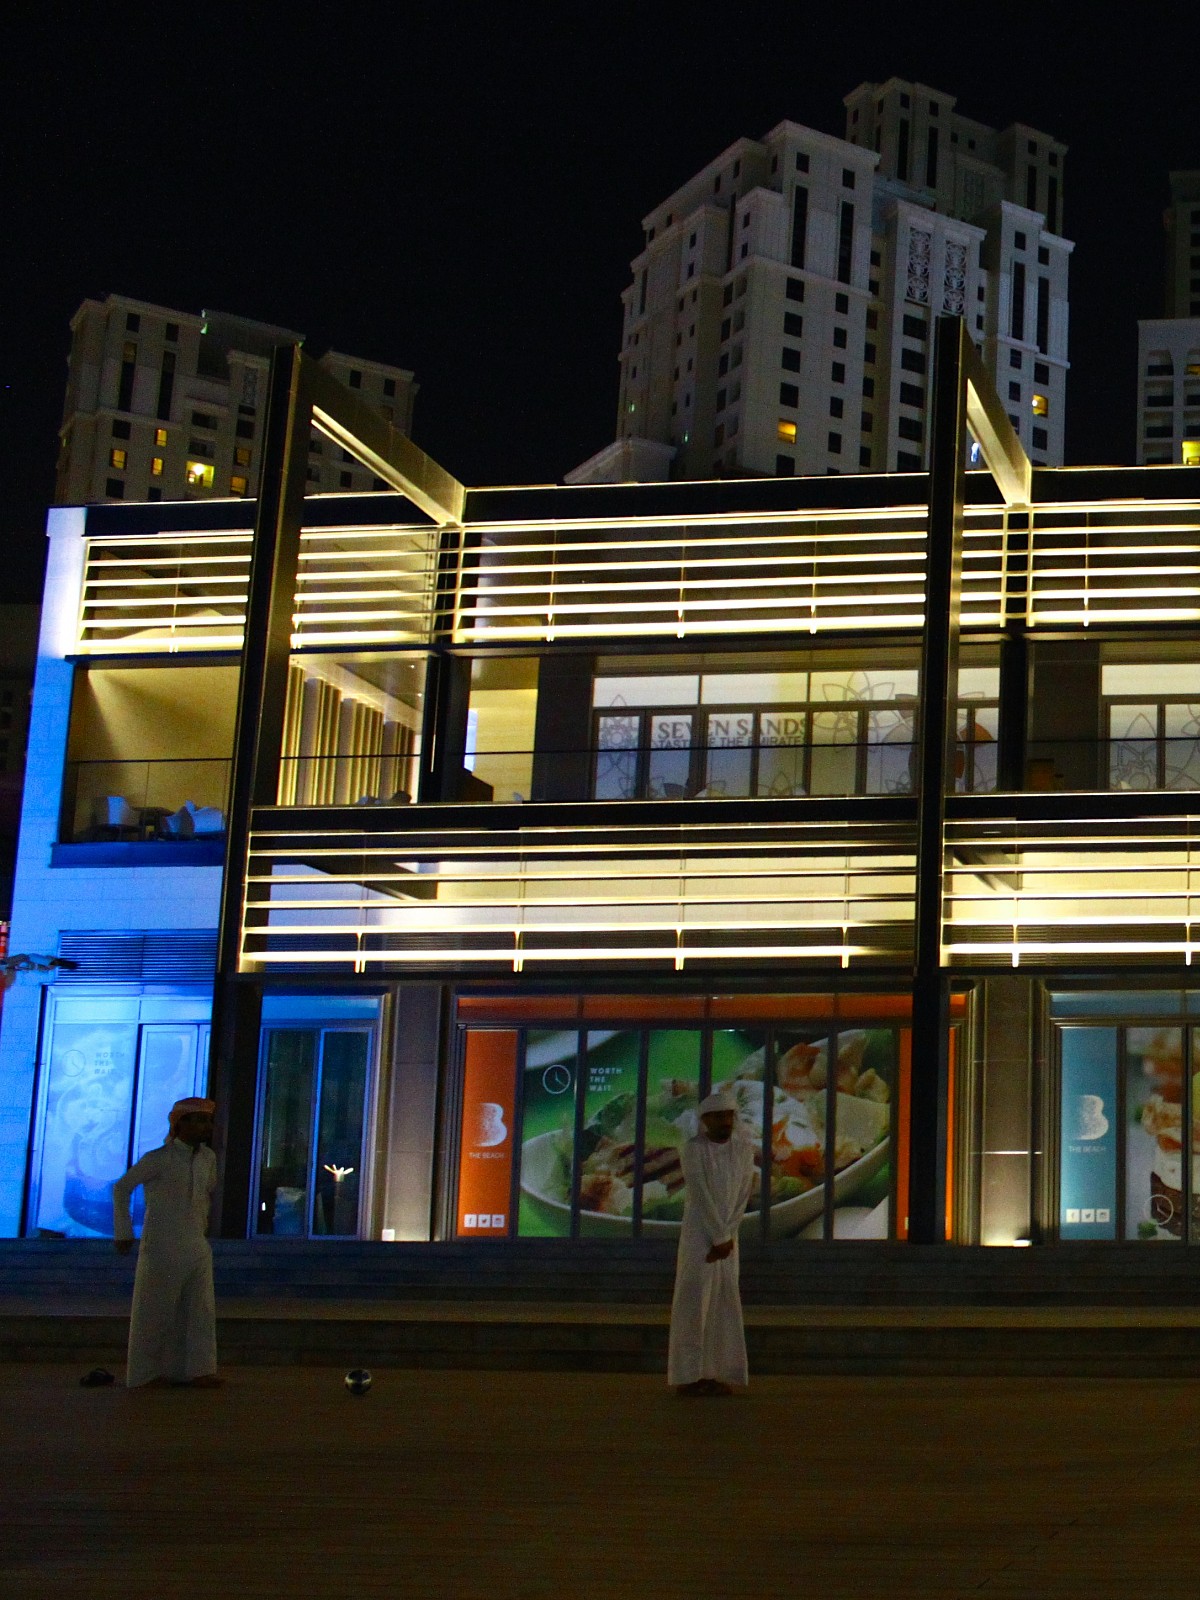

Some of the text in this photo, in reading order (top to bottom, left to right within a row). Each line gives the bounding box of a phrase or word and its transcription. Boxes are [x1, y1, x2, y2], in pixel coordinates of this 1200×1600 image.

[657, 718, 807, 740] SEN SND
[659, 739, 691, 749] TAST
[720, 737, 744, 747] THE
[748, 735, 804, 746] EIRATE
[590, 1067, 624, 1075] WORTH
